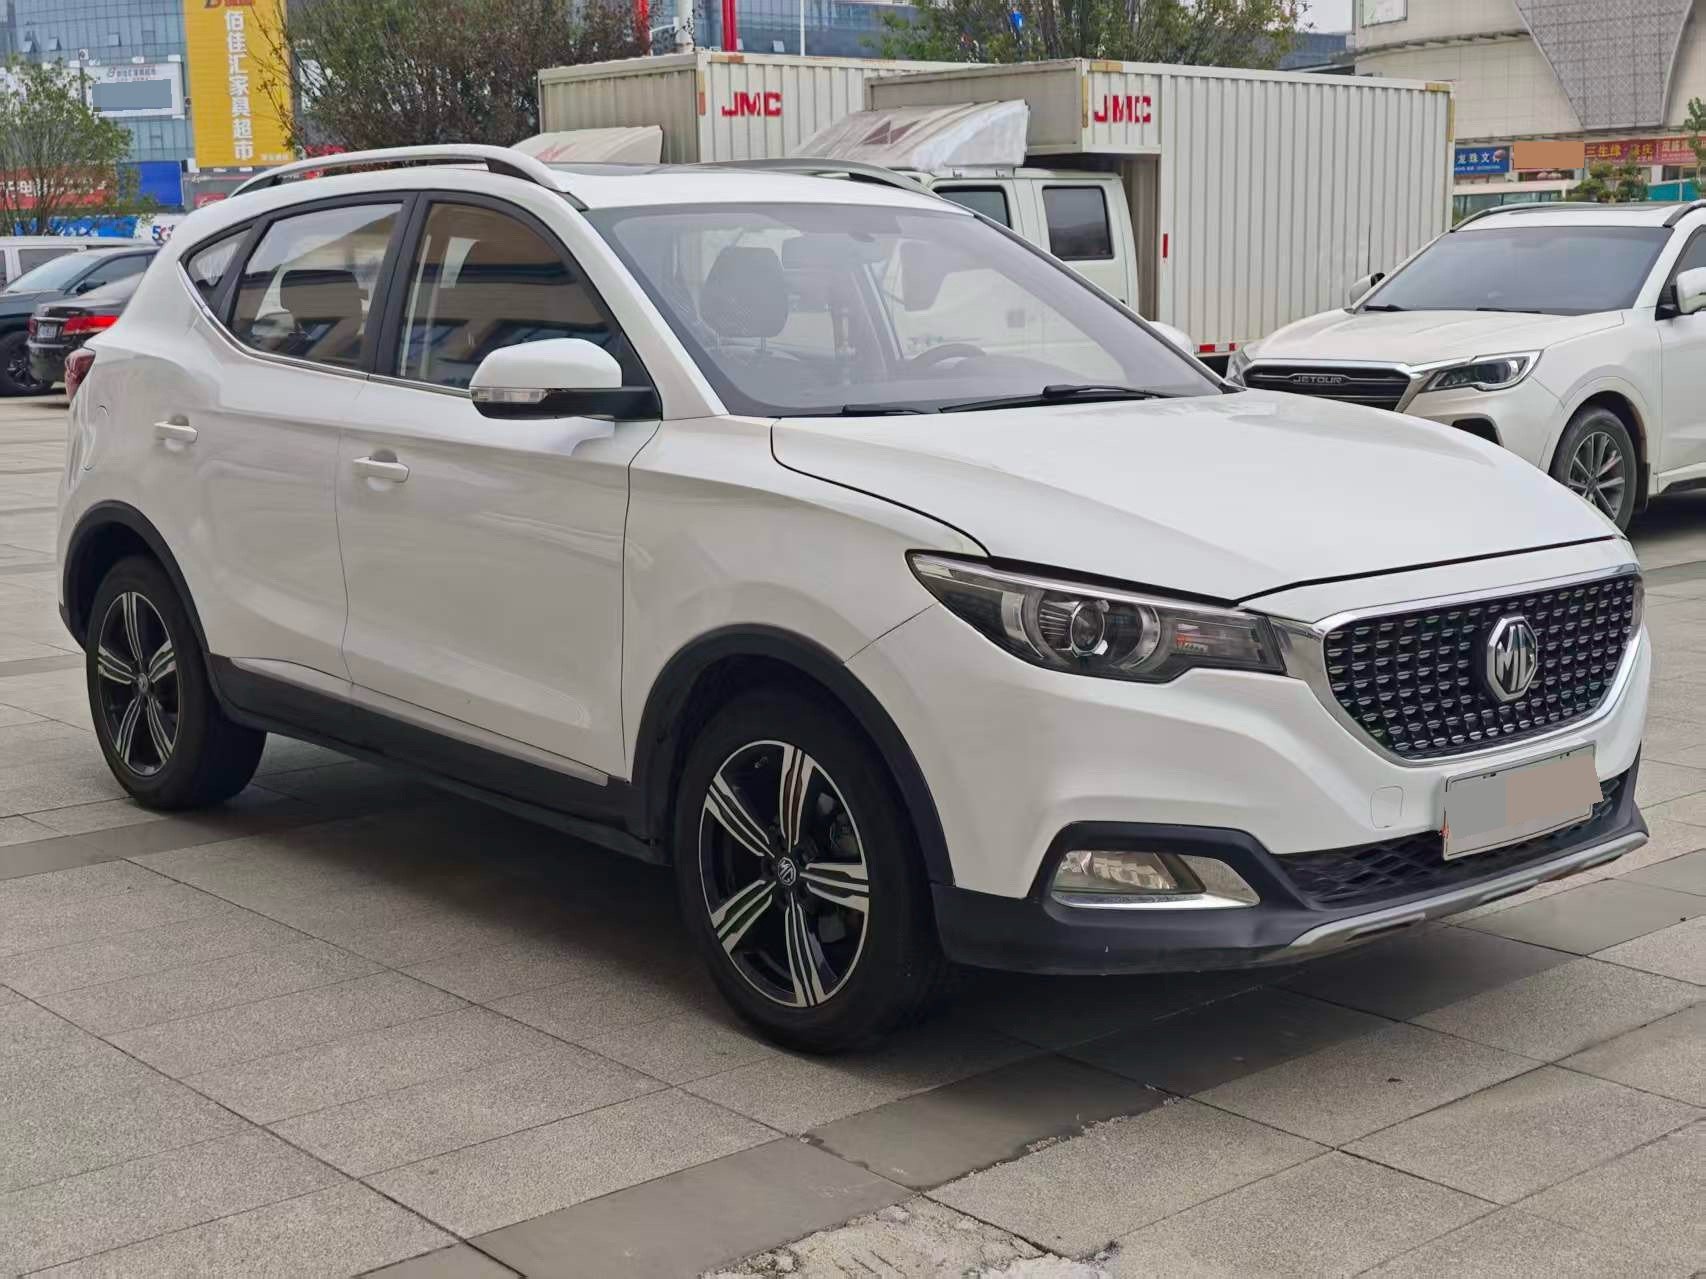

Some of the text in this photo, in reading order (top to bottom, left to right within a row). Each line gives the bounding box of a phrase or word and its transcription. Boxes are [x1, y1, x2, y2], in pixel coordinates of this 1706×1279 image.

[721, 92, 783, 117] JMC
[1094, 95, 1152, 123] JMC
[1293, 376, 1342, 384] JETOUR
[1493, 621, 1536, 695] MG
